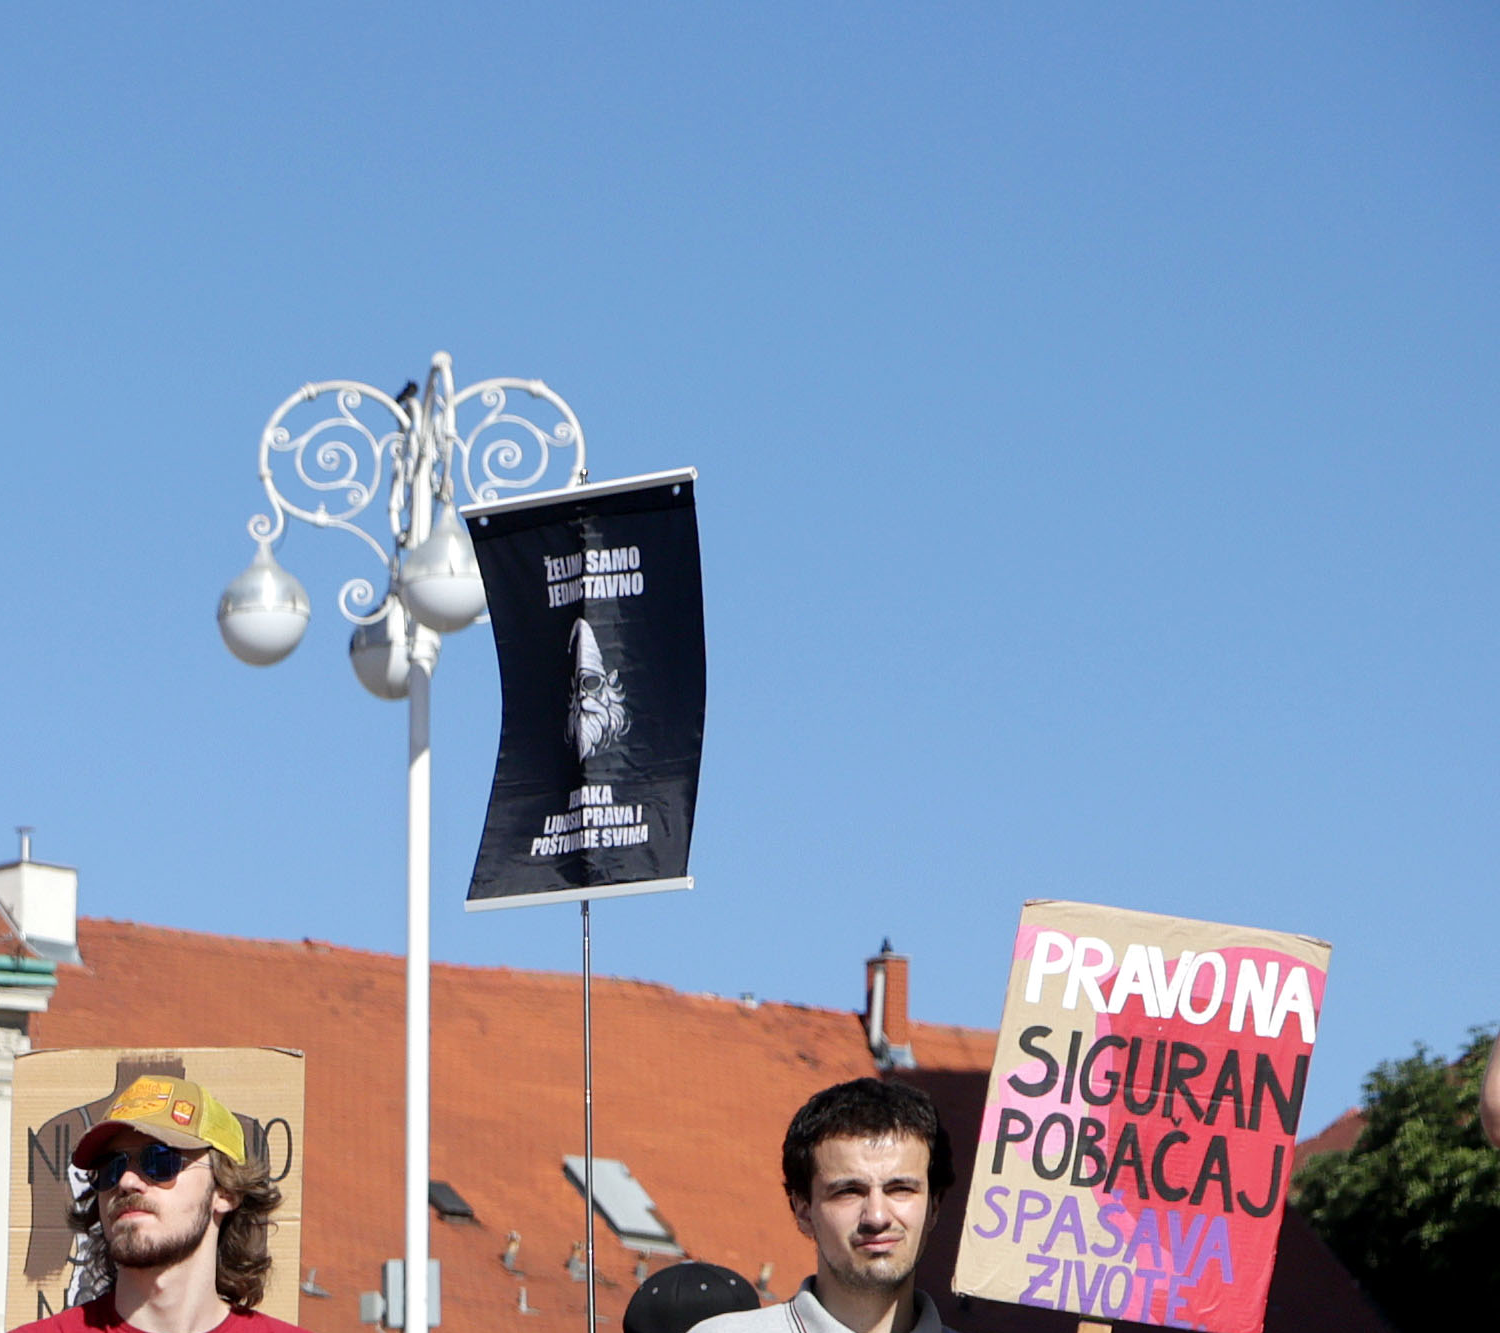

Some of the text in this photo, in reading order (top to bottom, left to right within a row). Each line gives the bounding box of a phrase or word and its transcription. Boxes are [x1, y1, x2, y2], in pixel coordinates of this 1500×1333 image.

[586, 546, 640, 574] SAMO
[582, 806, 634, 827] PRAVA
[636, 804, 643, 823] I
[602, 824, 649, 848] SVIMA
[1024, 930, 1316, 1044] PRAVO NA
[1007, 1025, 1311, 1136] SIGURAN
[990, 1107, 1285, 1219] POBAČAJ
[972, 1185, 1234, 1284] SPAŠAVA
